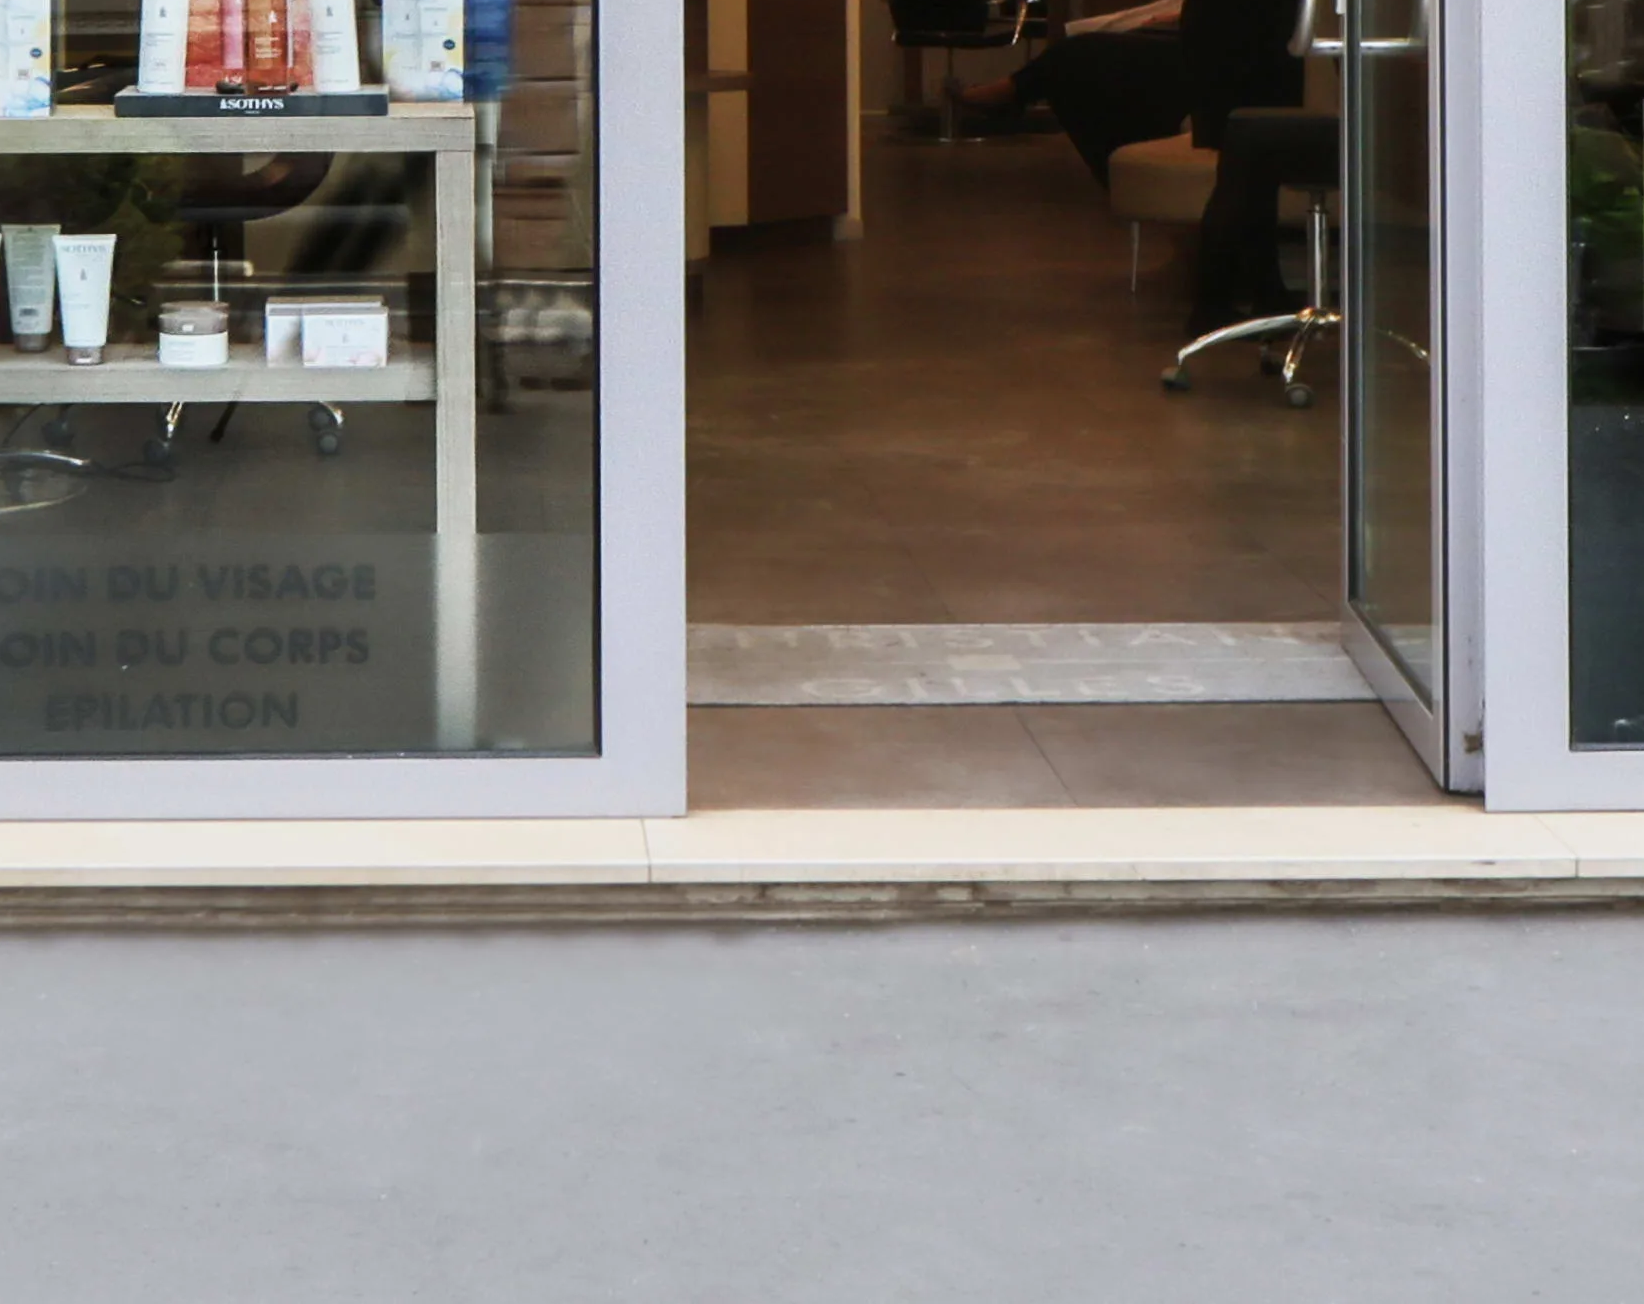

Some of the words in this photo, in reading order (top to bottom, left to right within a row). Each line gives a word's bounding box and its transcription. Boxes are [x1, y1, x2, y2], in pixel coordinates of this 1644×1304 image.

[227, 98, 285, 110] SOTHYS
[107, 565, 181, 601] DU
[198, 562, 377, 602] VISAGE
[116, 629, 186, 667] DU
[207, 626, 371, 666] CORPS
[44, 691, 300, 733] EPILATION
